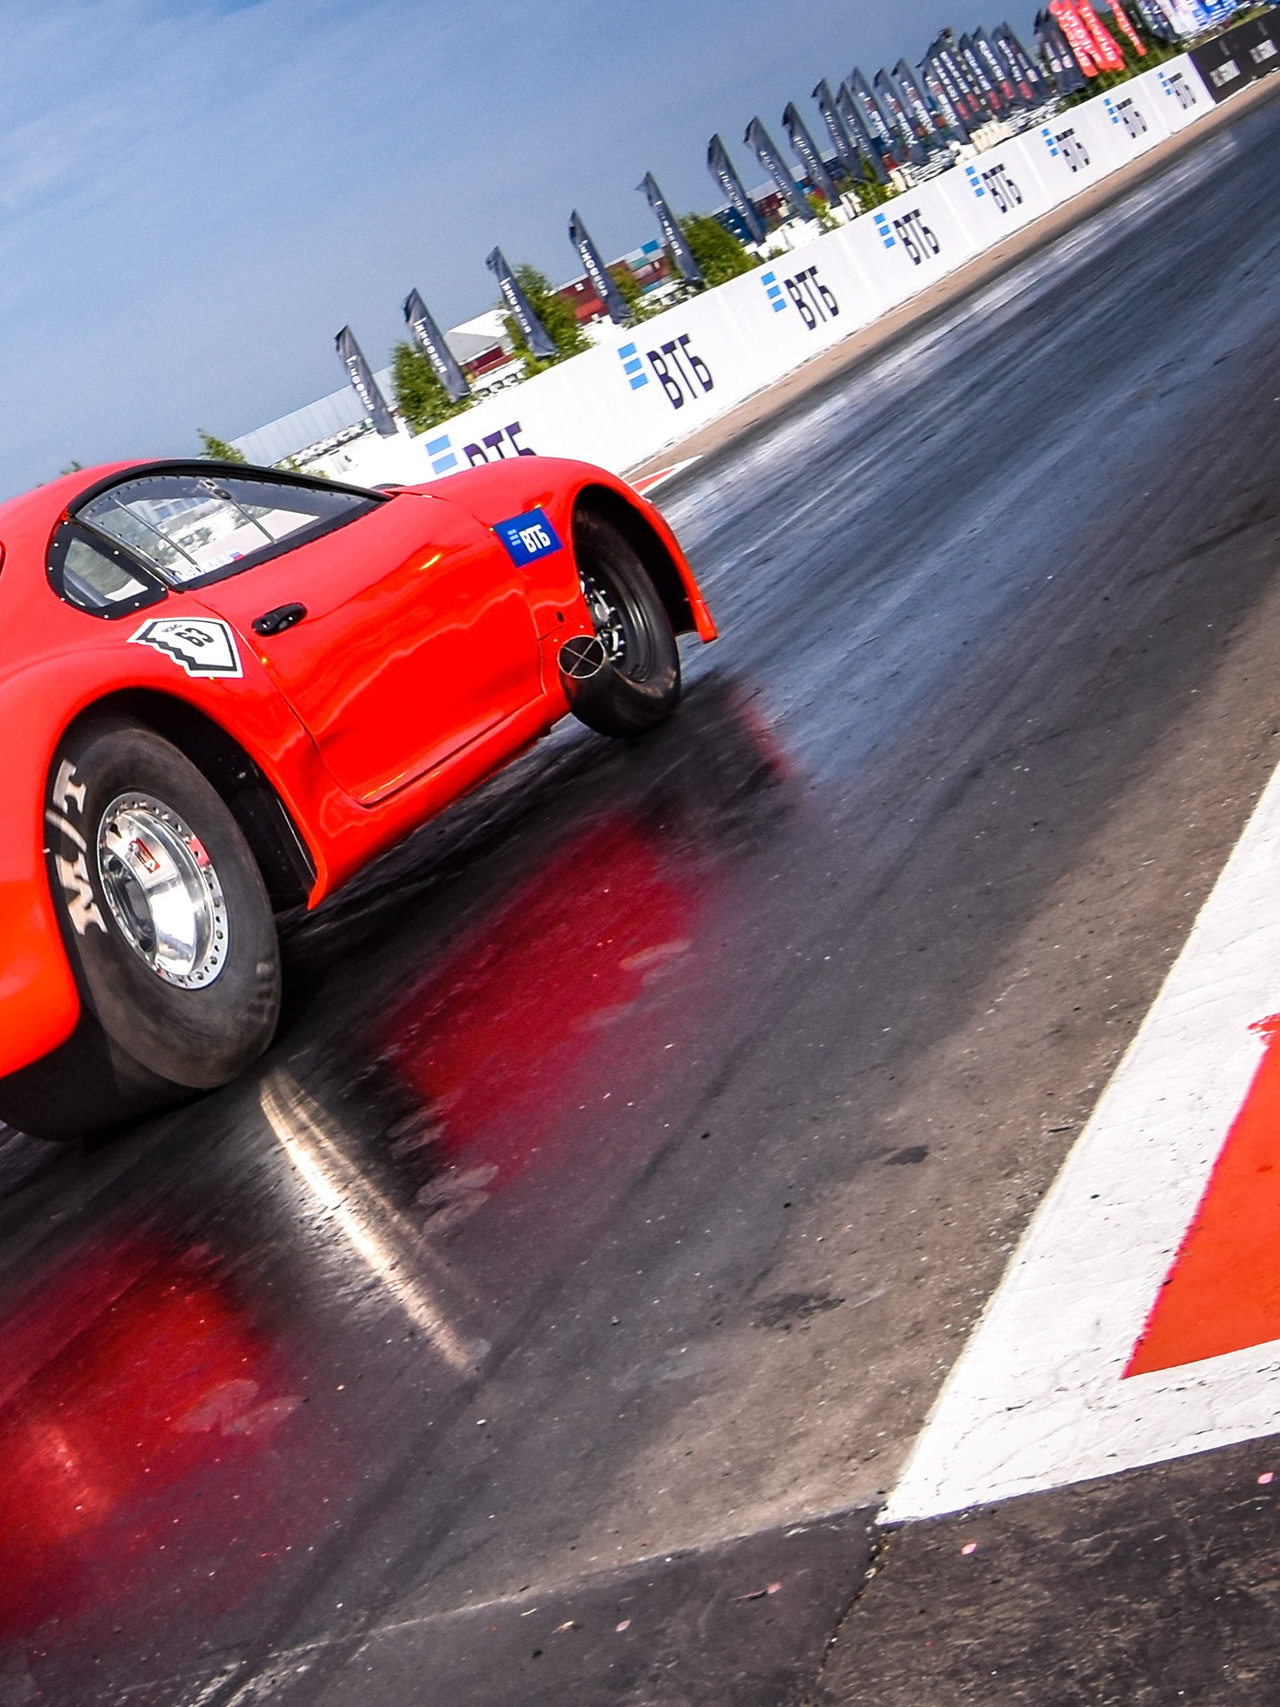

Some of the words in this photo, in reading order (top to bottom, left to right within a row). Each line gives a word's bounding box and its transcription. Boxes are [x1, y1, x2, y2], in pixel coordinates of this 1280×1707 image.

[893, 208, 940, 266] ВТБ
[784, 265, 838, 330] ВТБ
[646, 333, 714, 410] ВТБ
[519, 524, 551, 553] ВТБ
[174, 627, 215, 647] 63
[45, 759, 108, 935] M/T
